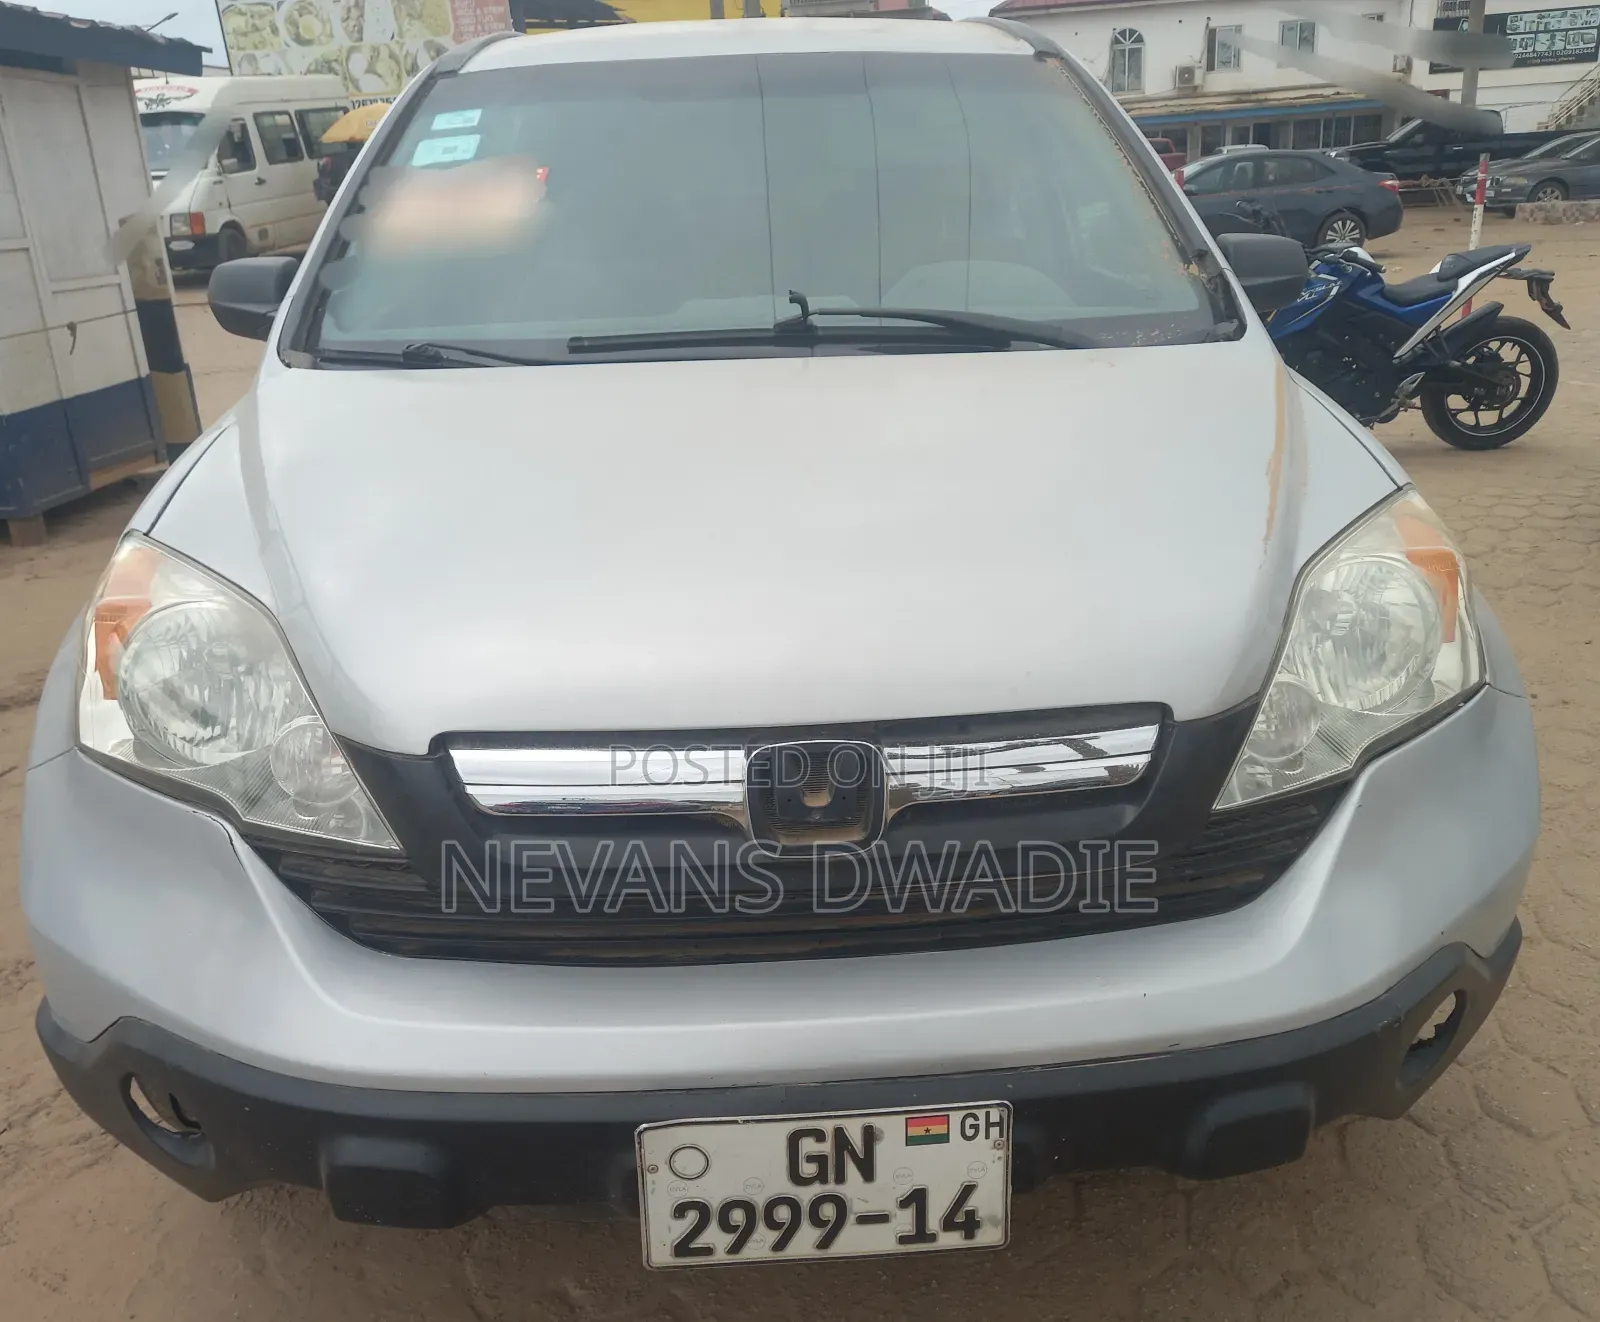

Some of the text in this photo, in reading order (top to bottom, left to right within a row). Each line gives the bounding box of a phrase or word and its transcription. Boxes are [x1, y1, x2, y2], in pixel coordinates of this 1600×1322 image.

[786, 1123, 876, 1187] GN
[960, 1110, 1004, 1141] GH
[672, 1182, 982, 1258] 2999-14
